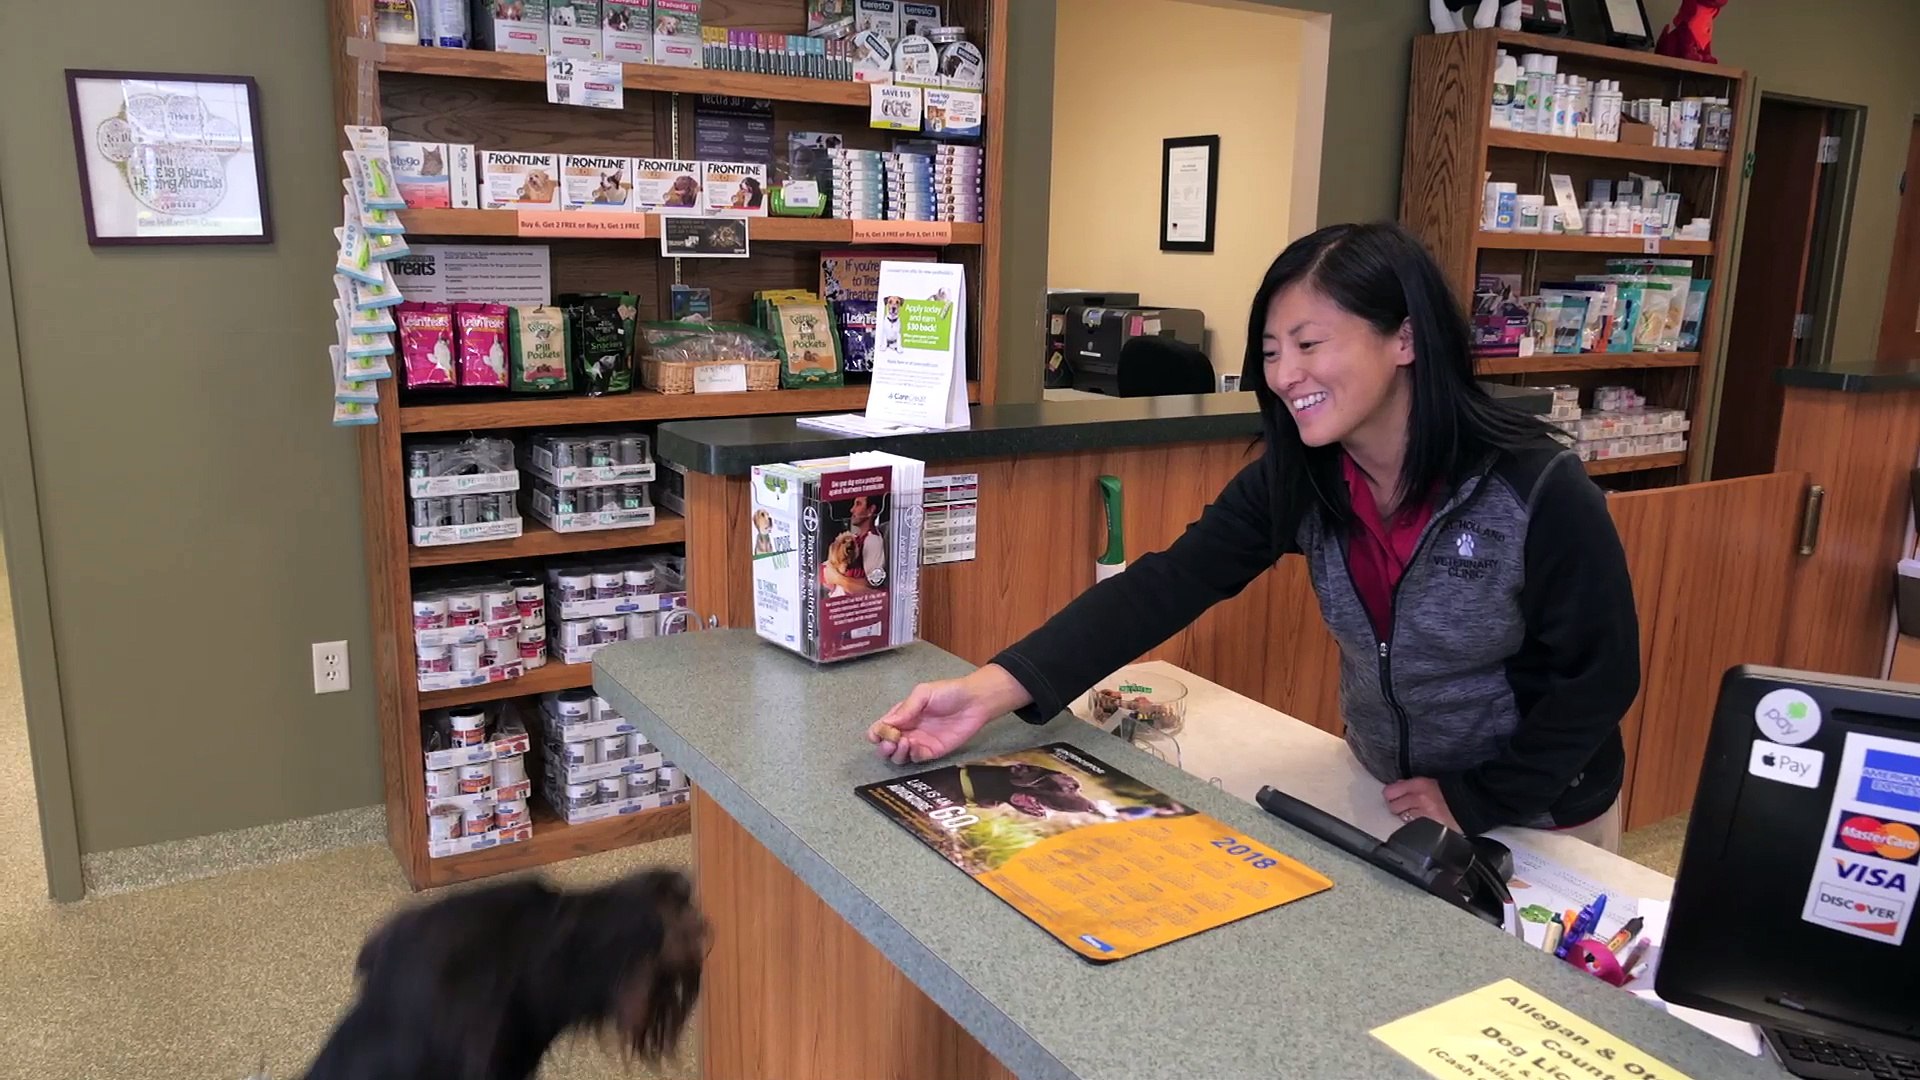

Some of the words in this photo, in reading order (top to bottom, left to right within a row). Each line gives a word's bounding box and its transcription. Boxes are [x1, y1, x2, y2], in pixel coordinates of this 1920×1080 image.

[862, 1, 891, 10] seresto
[906, 6, 934, 16] seresto
[552, 61, 573, 75] $12
[882, 89, 898, 98] SAVE
[488, 153, 551, 166] FRONTLINE
[566, 156, 626, 169] FRONTLINE
[637, 159, 695, 173] FRONTLINE
[707, 163, 761, 176] FRONTLINE
[521, 221, 533, 229] Buy
[586, 222, 599, 230] Buy
[393, 260, 436, 276] Treats
[845, 259, 854, 271] If
[852, 276, 863, 287] to
[905, 304, 923, 313] Apply
[924, 305, 942, 315] today
[910, 314, 921, 322] and
[800, 332, 815, 340] Pill
[535, 343, 551, 351] Pill
[793, 340, 826, 349] Pockets
[527, 351, 560, 359] Pockets
[1459, 520, 1506, 542] HOLLAND
[807, 534, 816, 570] Bayer
[1433, 555, 1499, 569] VETERINARY
[1447, 566, 1485, 580] CLINIC
[807, 572, 816, 642] HealthCare
[1764, 708, 1799, 735] pay
[1779, 755, 1812, 778] Pay
[906, 779, 932, 792] LIFE
[1841, 825, 1918, 851] MasterCard
[1210, 837, 1277, 870] 2018
[1835, 860, 1906, 893] VISA
[1820, 892, 1896, 920] DISCOVER
[1500, 996, 1591, 1046] Allegan
[1596, 1048, 1616, 1061] &
[1481, 1026, 1528, 1057] Dog
[1532, 1057, 1572, 1080] Lic
[1428, 1047, 1475, 1077] (Cash
